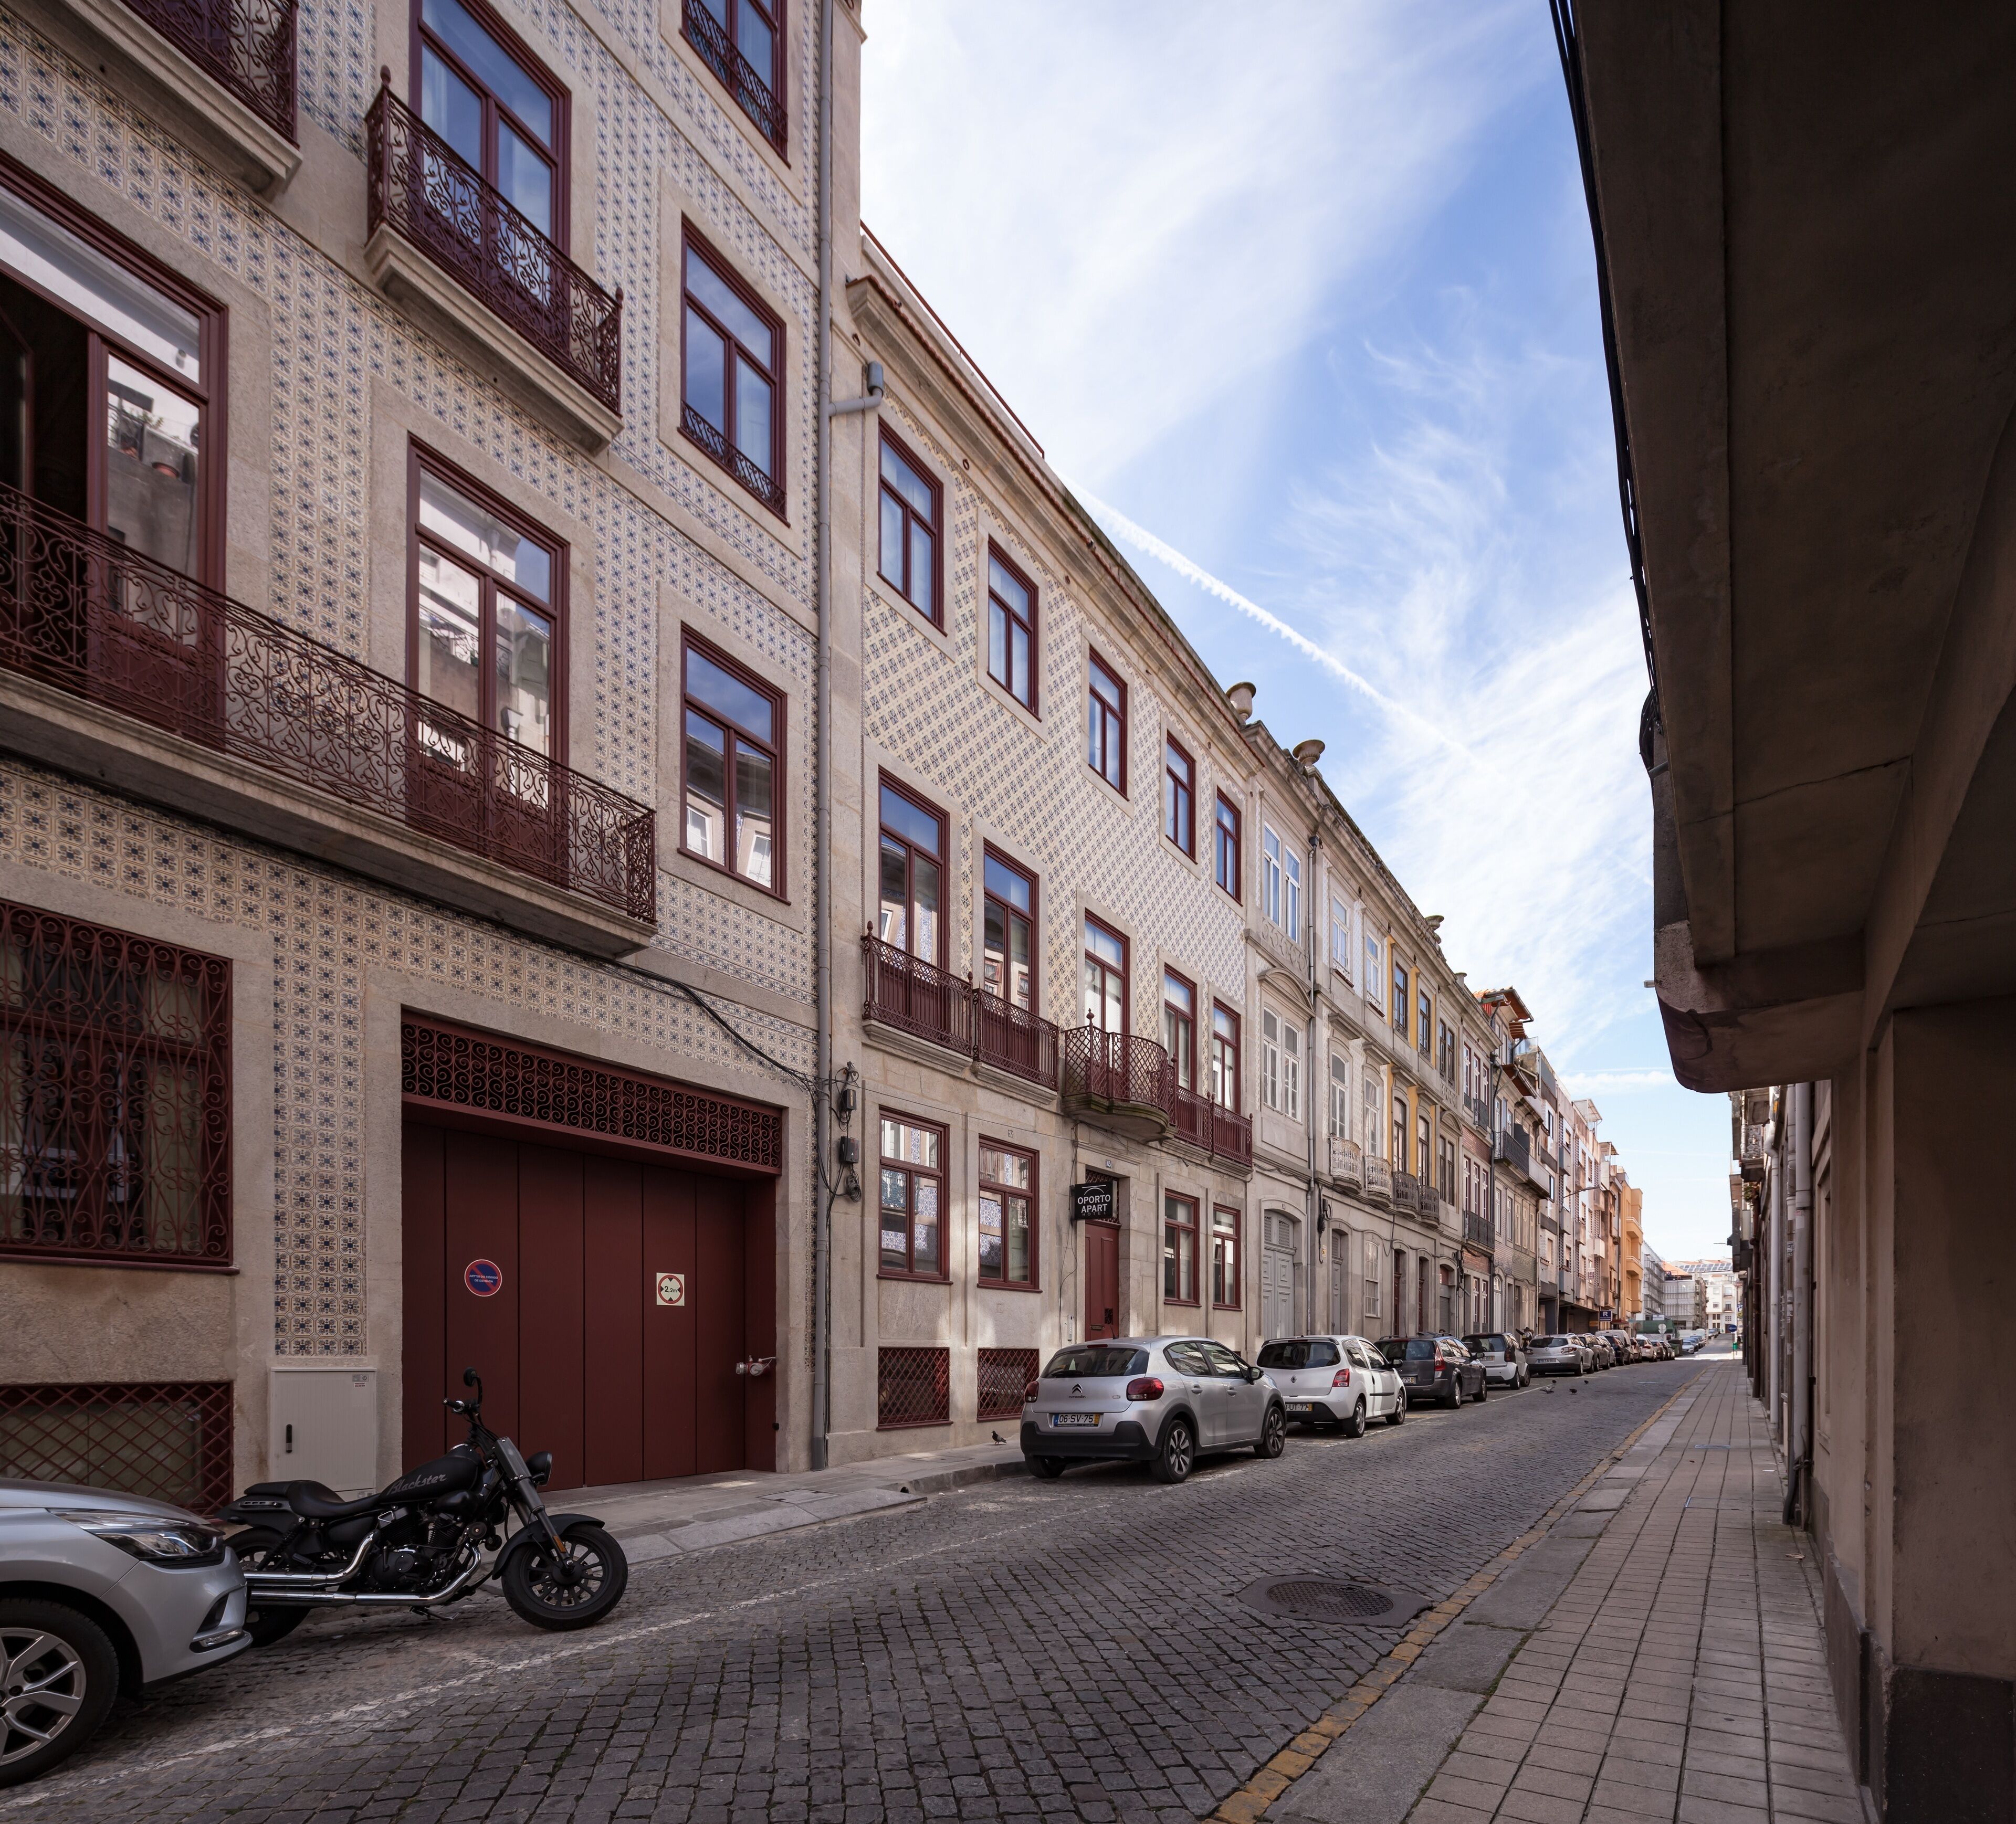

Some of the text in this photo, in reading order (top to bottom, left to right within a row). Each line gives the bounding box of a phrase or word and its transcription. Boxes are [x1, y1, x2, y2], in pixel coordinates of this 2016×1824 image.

[1077, 1195, 1110, 1204] OPORTO
[1081, 1204, 1107, 1214] APART
[386, 1474, 447, 1495] Blackster
